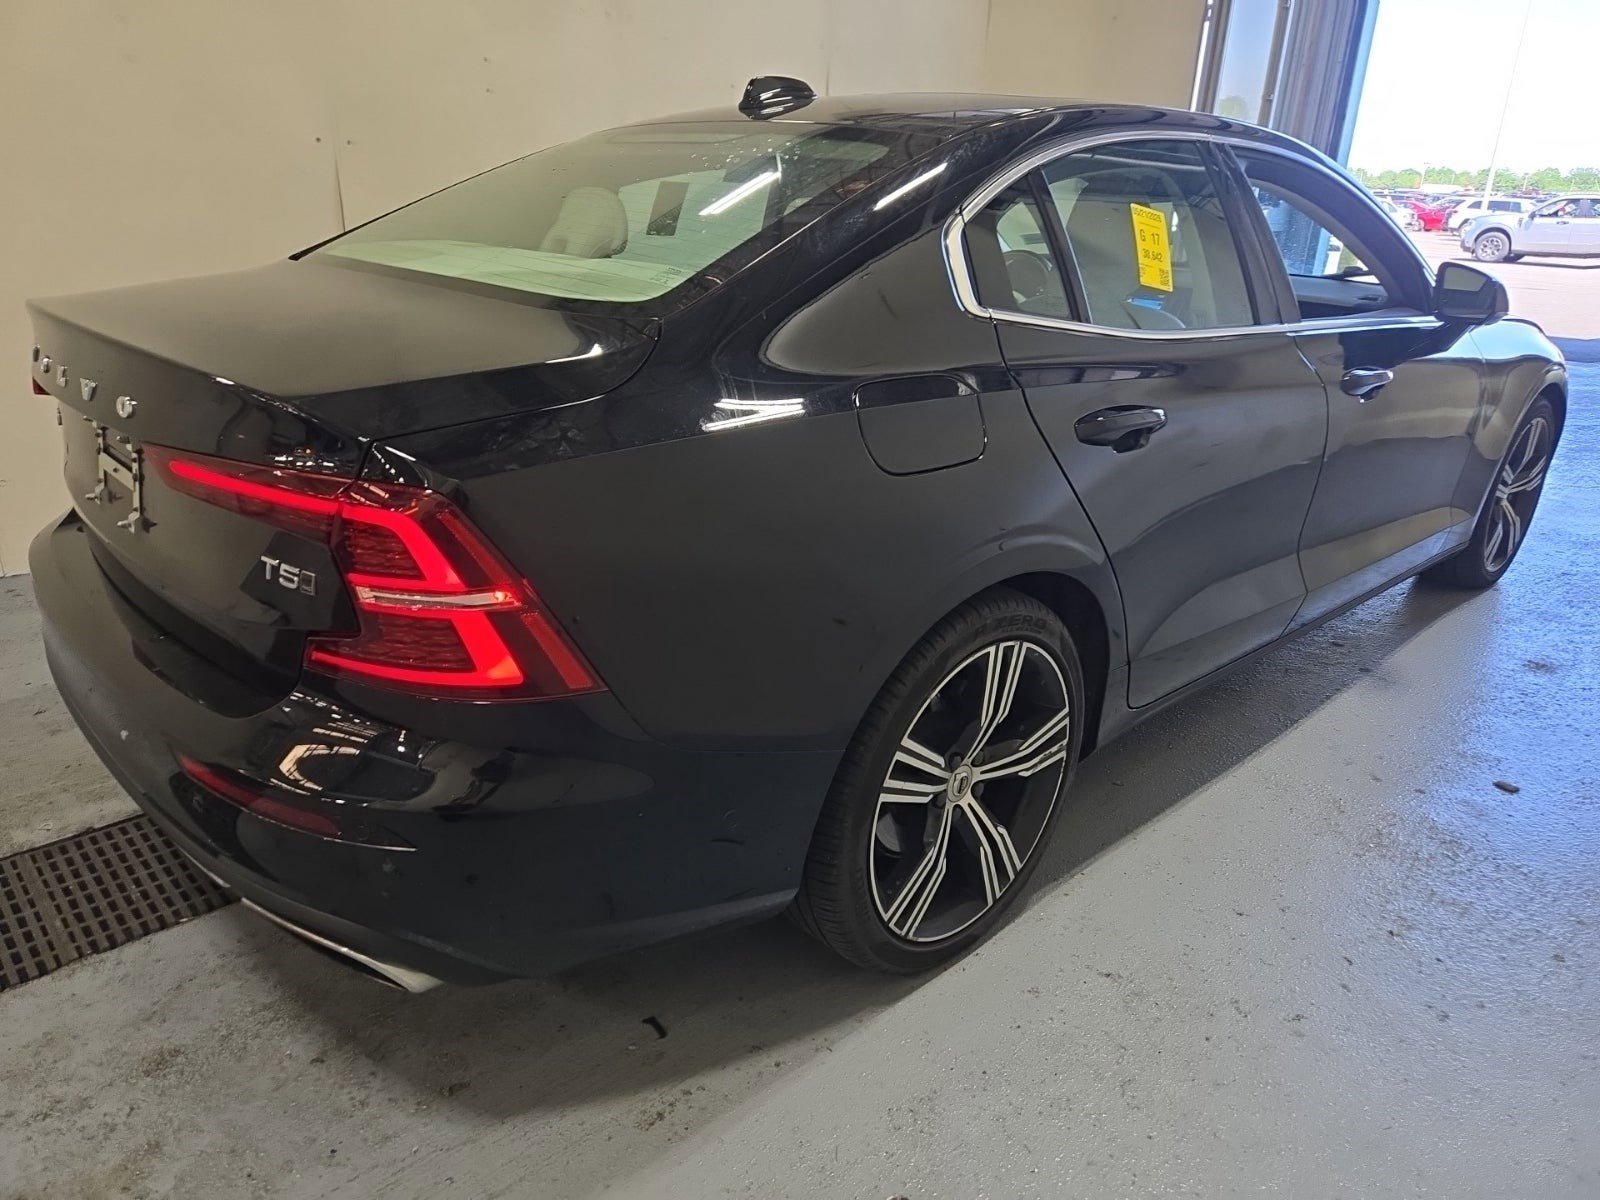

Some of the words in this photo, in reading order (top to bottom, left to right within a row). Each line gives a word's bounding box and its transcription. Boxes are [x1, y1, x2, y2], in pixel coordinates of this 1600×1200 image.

[1139, 229, 1146, 242] G
[1151, 232, 1160, 246] 17
[261, 555, 300, 589] T5
